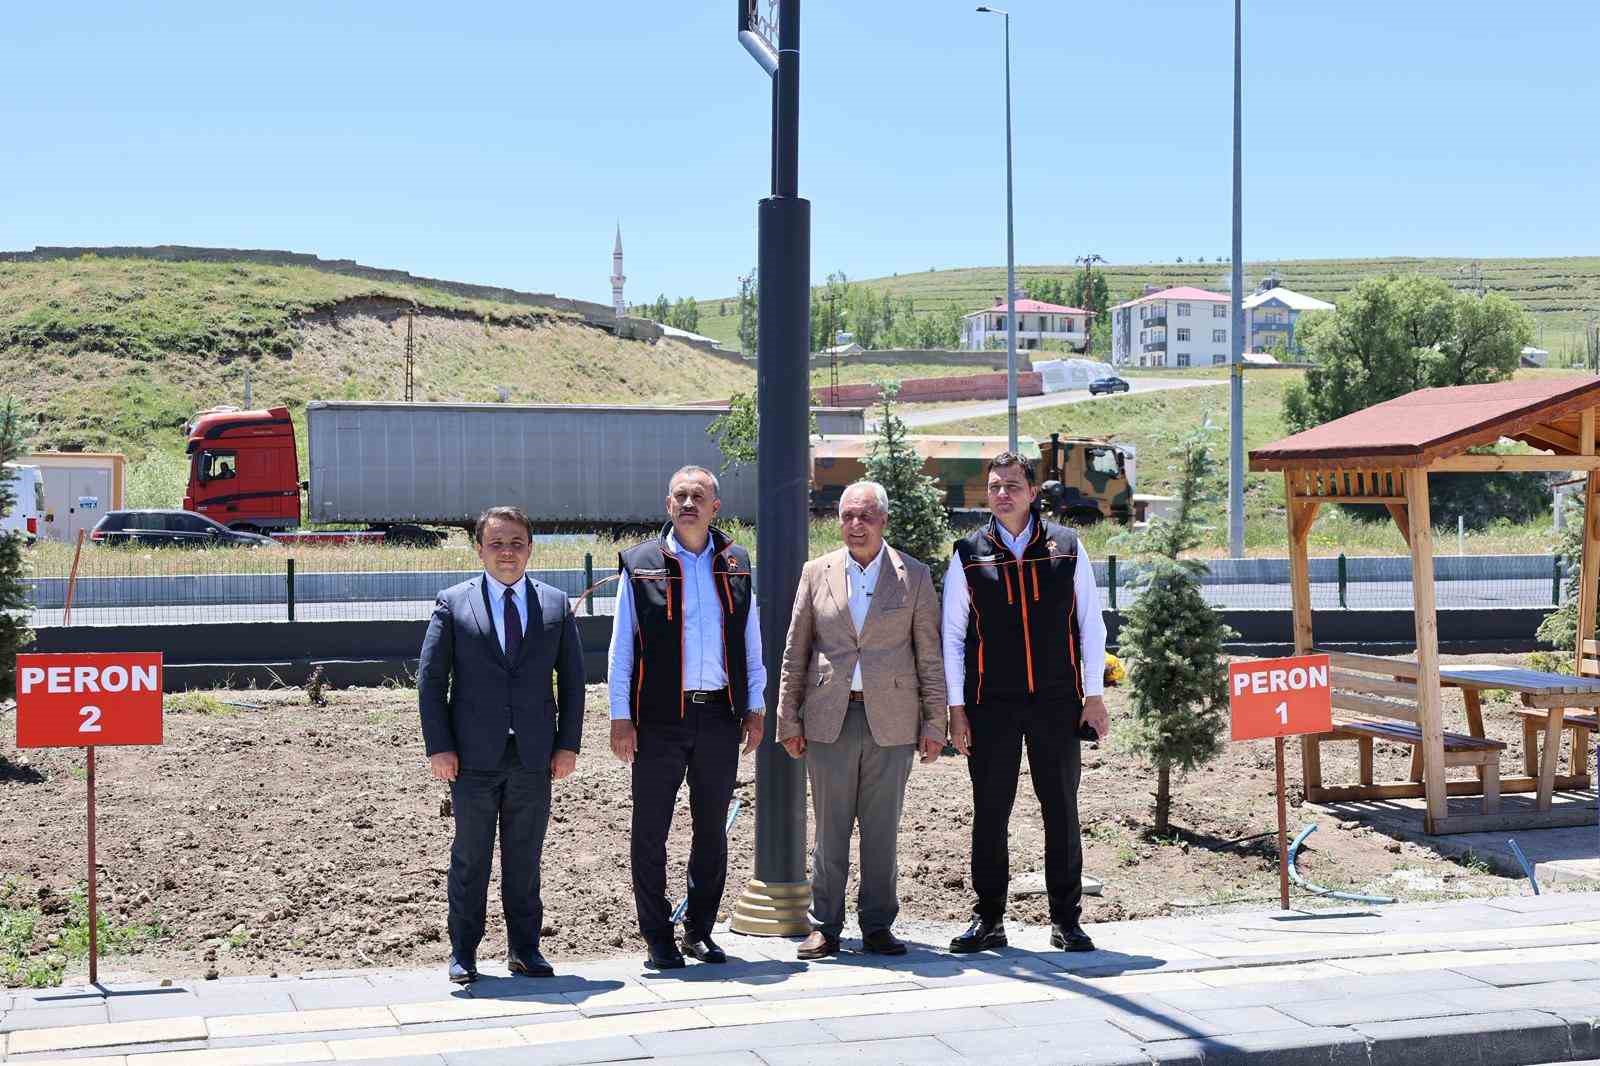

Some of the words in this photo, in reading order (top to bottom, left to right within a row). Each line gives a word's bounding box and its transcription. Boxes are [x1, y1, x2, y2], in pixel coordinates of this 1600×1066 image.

[21, 665, 158, 694] PERON
[1232, 665, 1329, 696] PERON
[78, 705, 102, 732] 2
[1274, 701, 1289, 725] 1
